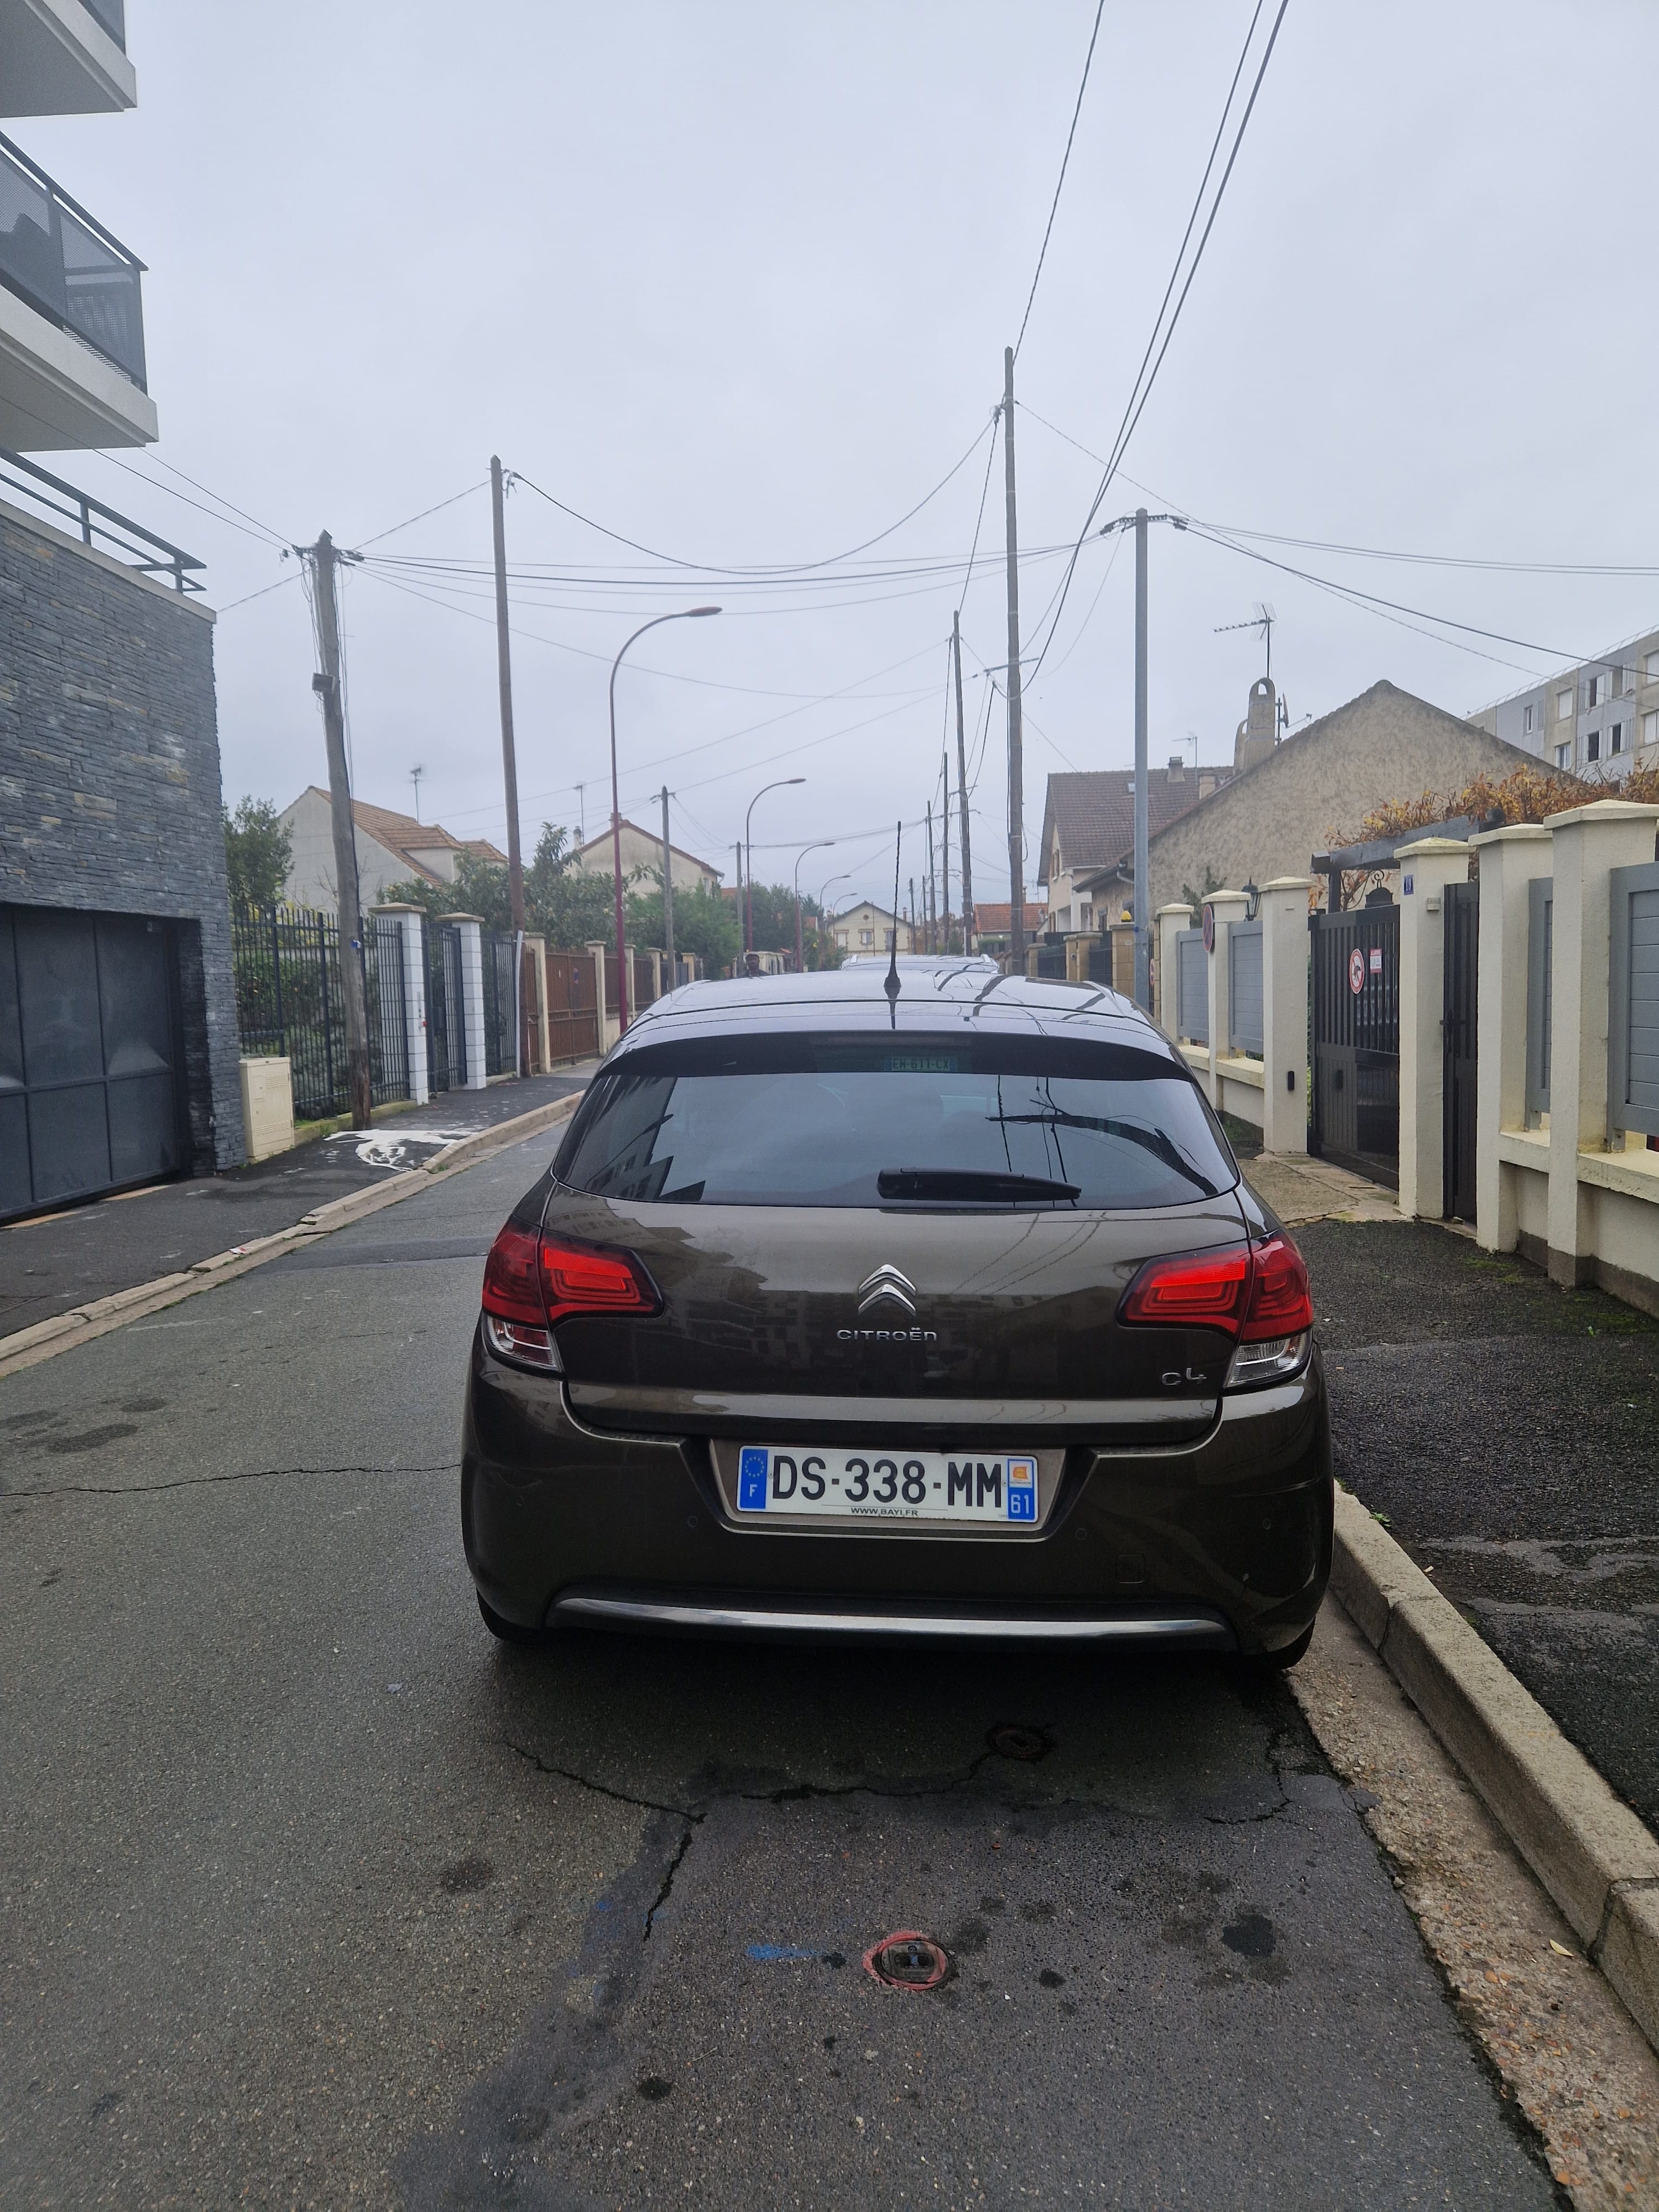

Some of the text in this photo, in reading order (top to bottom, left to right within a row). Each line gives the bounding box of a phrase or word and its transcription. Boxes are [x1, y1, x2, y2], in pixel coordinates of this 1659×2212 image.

[1162, 1368, 1207, 1385] C4
[773, 1455, 1001, 1508] DS-338-MM
[749, 1484, 758, 1498] F
[851, 1507, 919, 1516] WWW.BAYI.FR
[1010, 1494, 1030, 1514] 61
